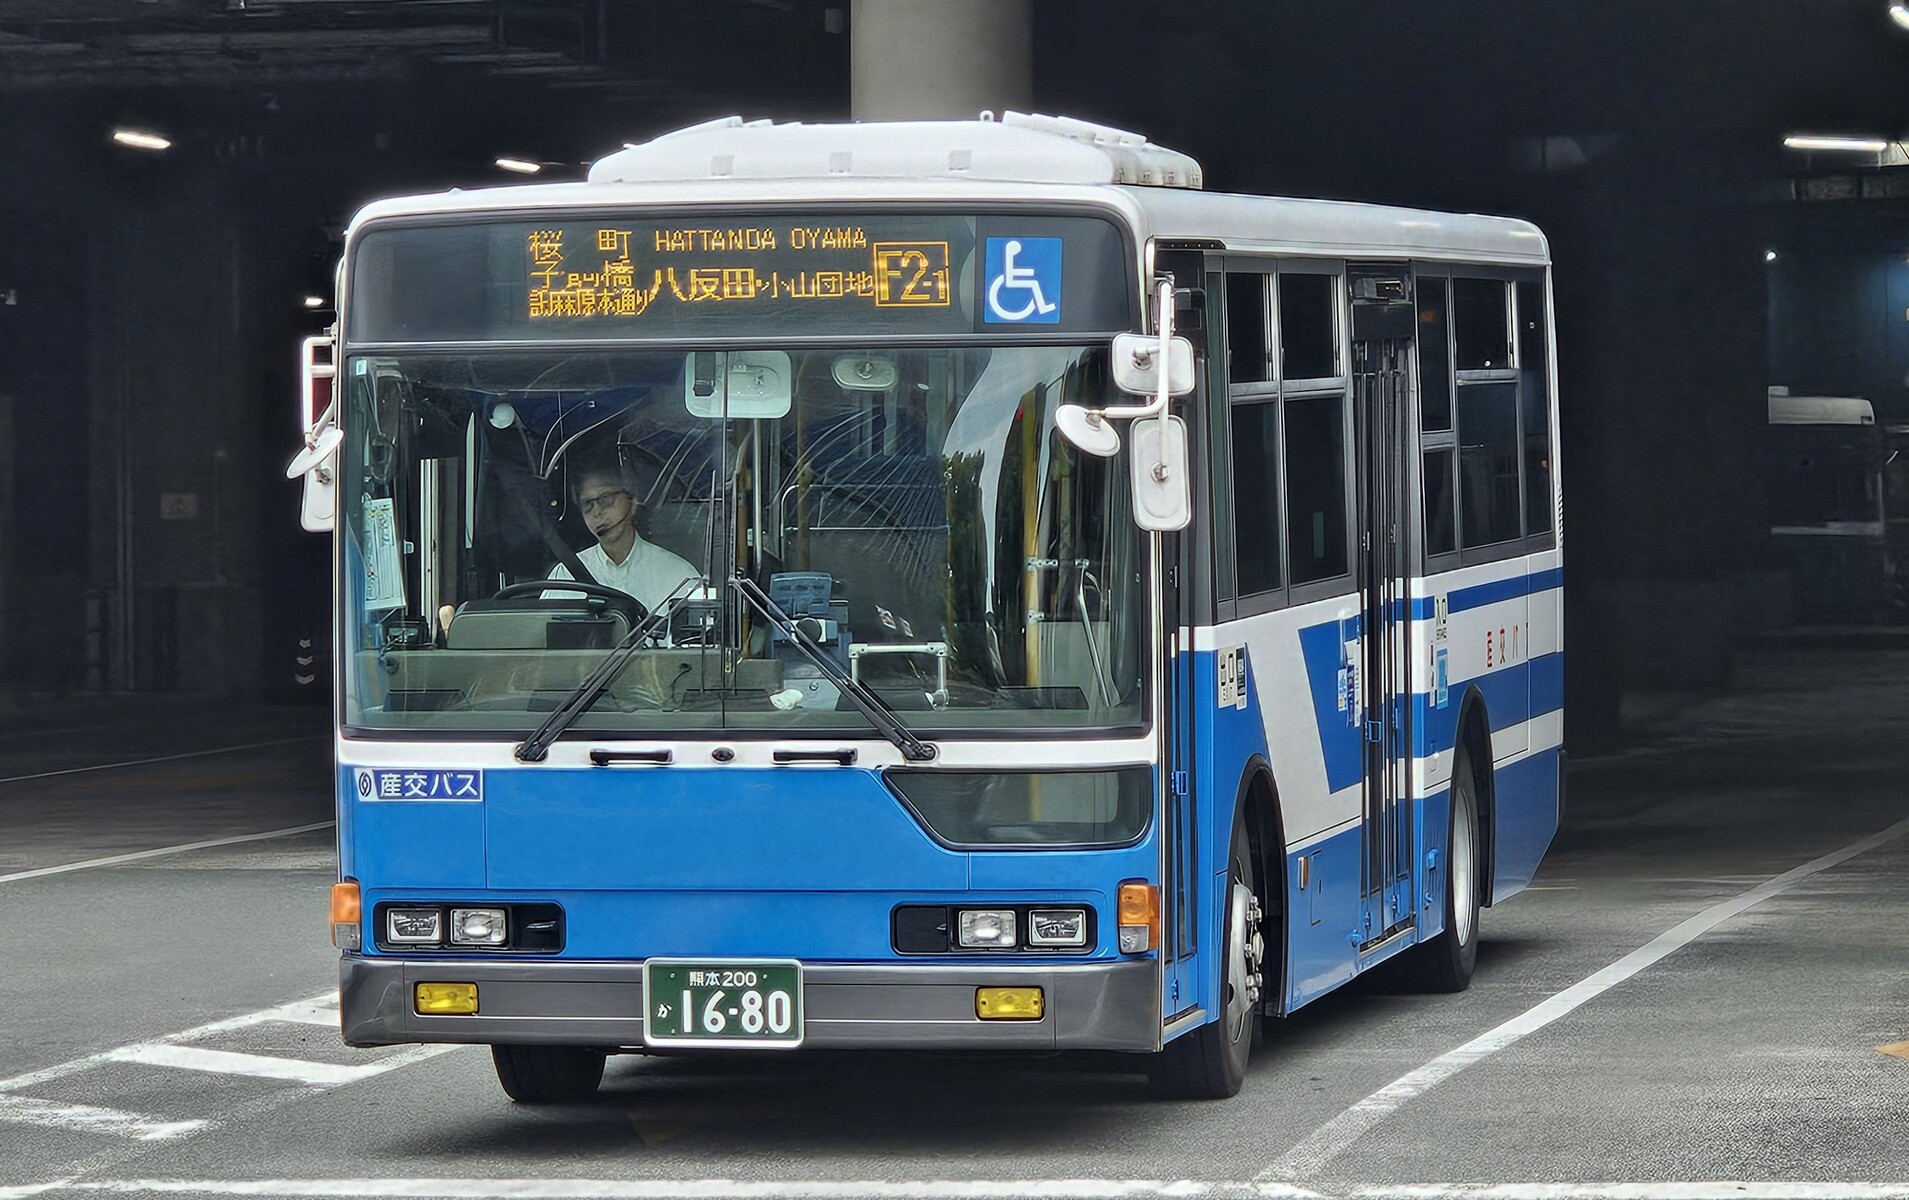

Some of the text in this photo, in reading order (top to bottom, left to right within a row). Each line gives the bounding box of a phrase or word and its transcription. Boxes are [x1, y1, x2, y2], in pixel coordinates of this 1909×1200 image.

[655, 227, 867, 251] HATTANDA OYAMA
[878, 250, 946, 300] F2-1
[381, 772, 478, 797] 産交バス
[657, 989, 791, 1034] か 16-80
